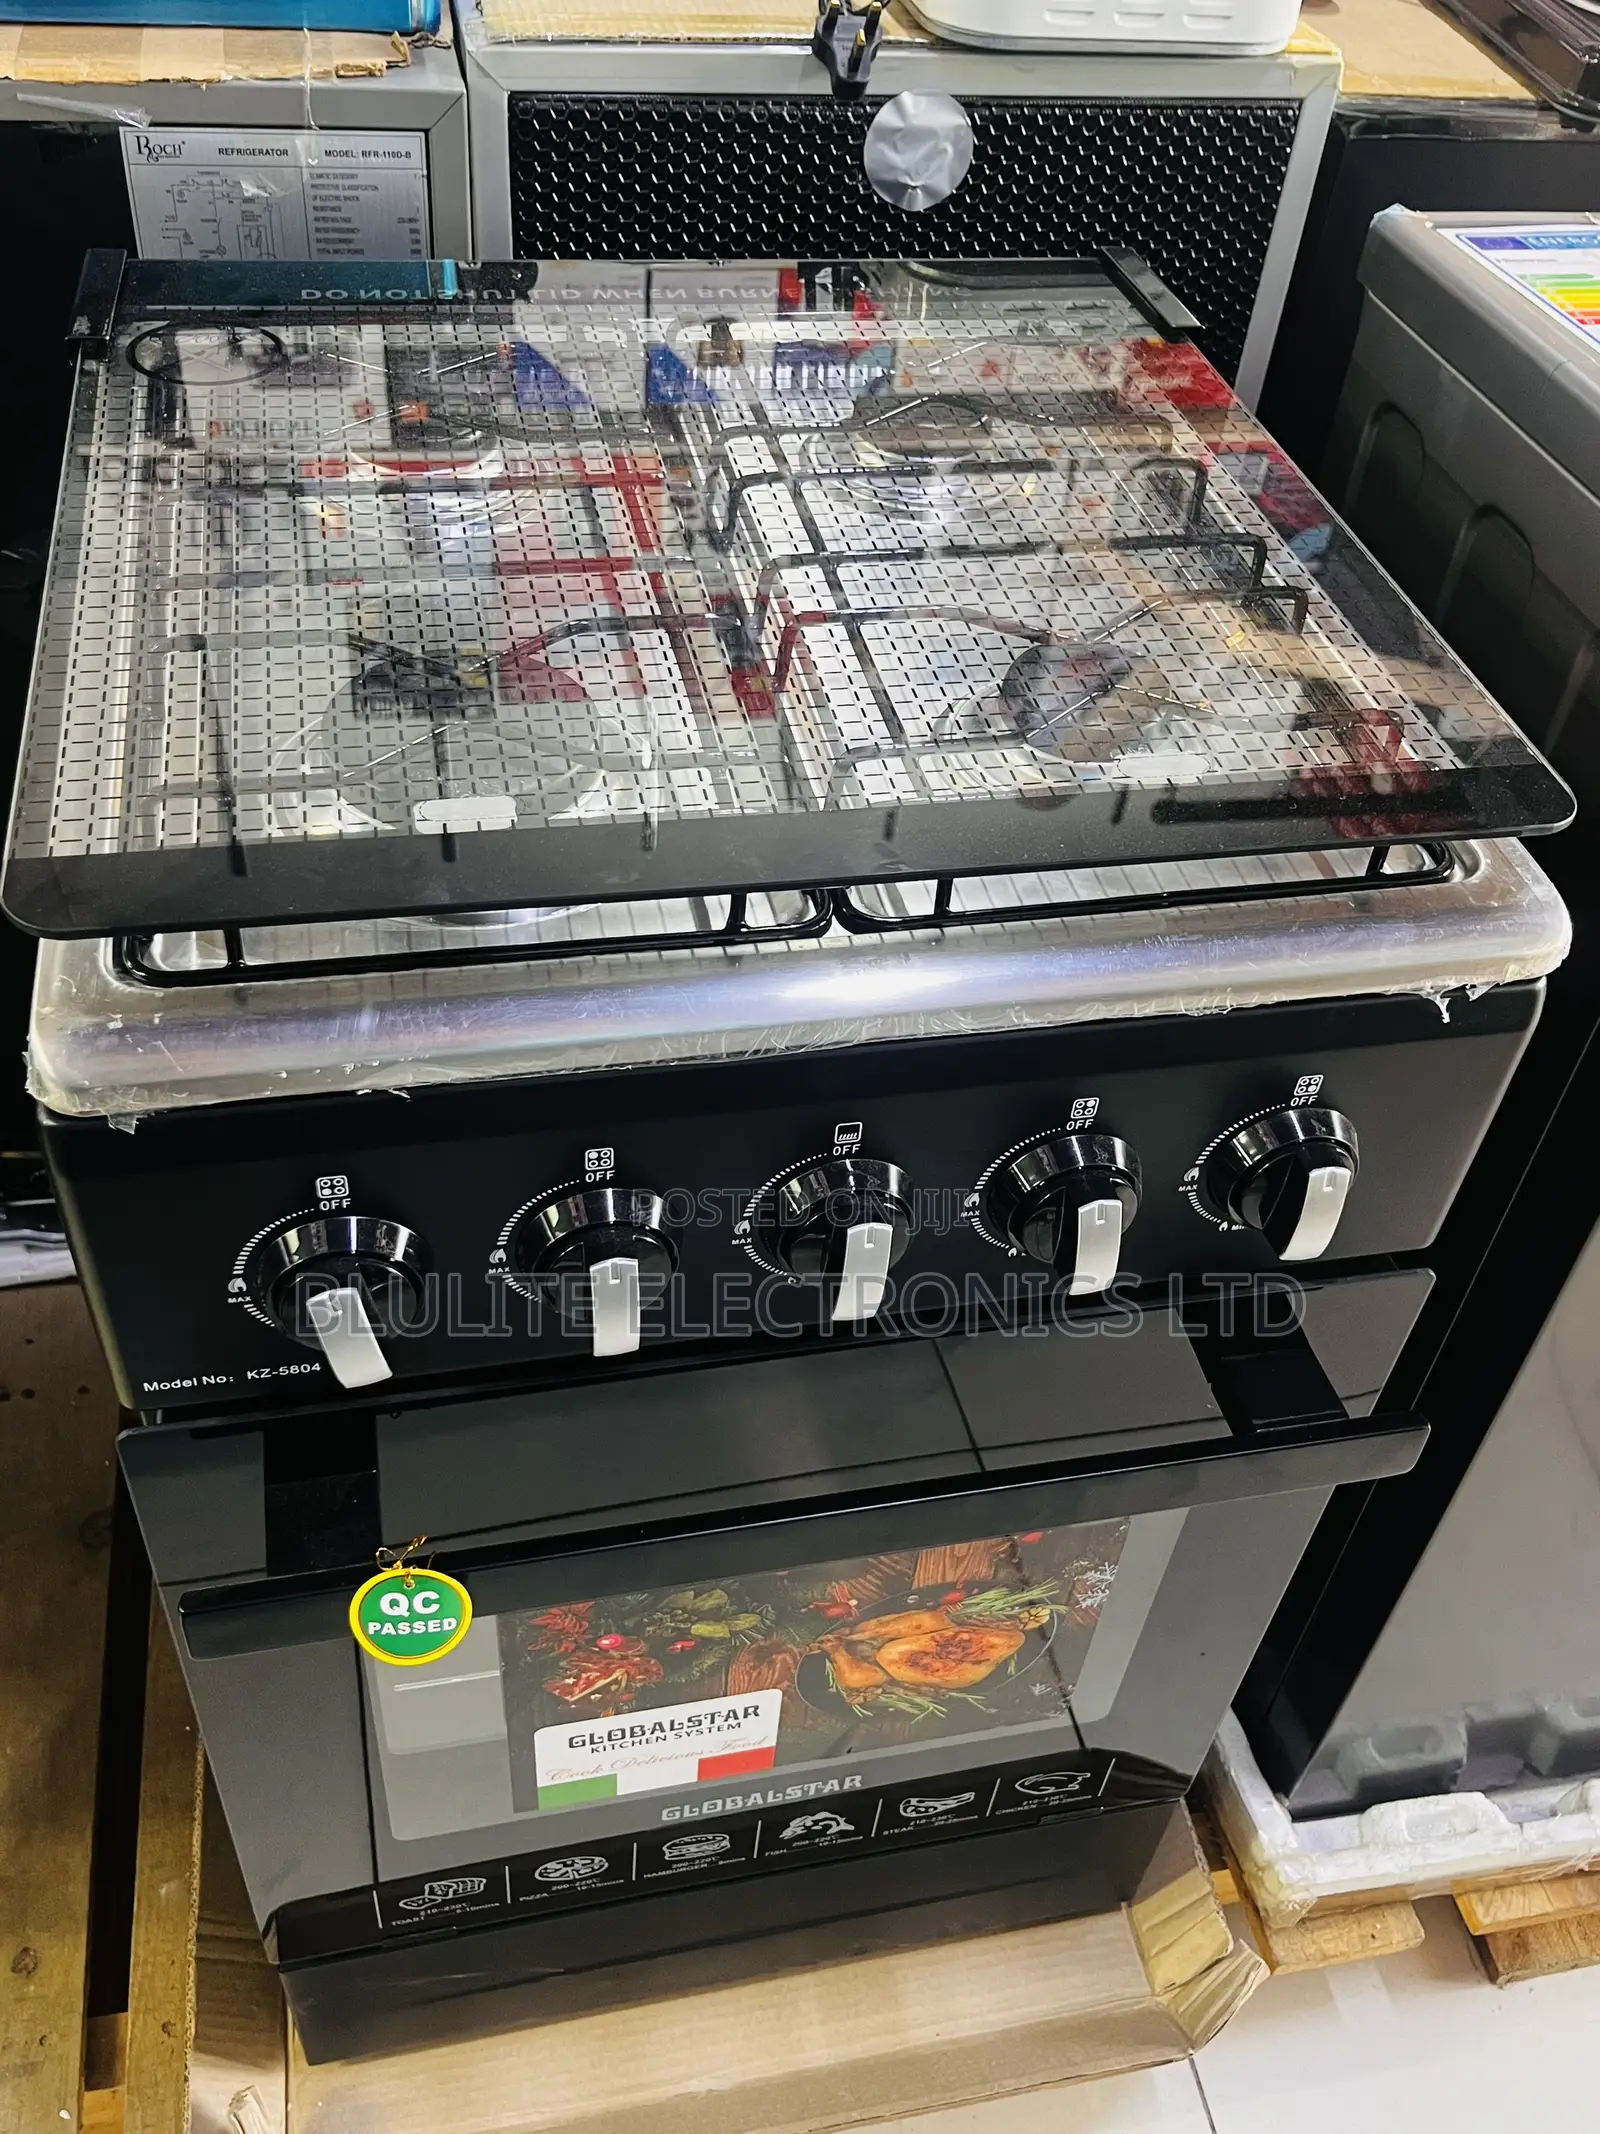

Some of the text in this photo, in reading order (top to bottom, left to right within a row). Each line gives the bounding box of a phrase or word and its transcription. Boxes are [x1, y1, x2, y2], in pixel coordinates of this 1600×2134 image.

[218, 147, 289, 157] REFRIGERATOR
[324, 149, 358, 158] MODEL:
[1290, 1094, 1318, 1107] OFF
[1065, 1119, 1094, 1132] OFF
[832, 1143, 861, 1157] OFF
[585, 1169, 615, 1183] OFF
[1178, 1184, 1198, 1192] MAX
[318, 1198, 352, 1211] OFF
[960, 1209, 981, 1218] MAX
[731, 1237, 753, 1246] MAX
[488, 1265, 511, 1275] MAX
[227, 1295, 252, 1304] MAX
[143, 1362, 322, 1392] Model No: KZ-5804
[380, 1591, 441, 1618] QC
[367, 1617, 458, 1635] PASSED
[568, 1704, 761, 1749] GLOBALSTAR
[590, 1722, 742, 1754] KITCHEN SYSTEM
[661, 1775, 863, 1822] GLOBALSTAR
[882, 1826, 914, 1836] STEAK
[765, 1848, 787, 1857] FISH
[643, 1863, 708, 1878] HAMBURGER
[519, 1892, 549, 1902] PIZZA
[391, 1915, 425, 1926] TOAST
